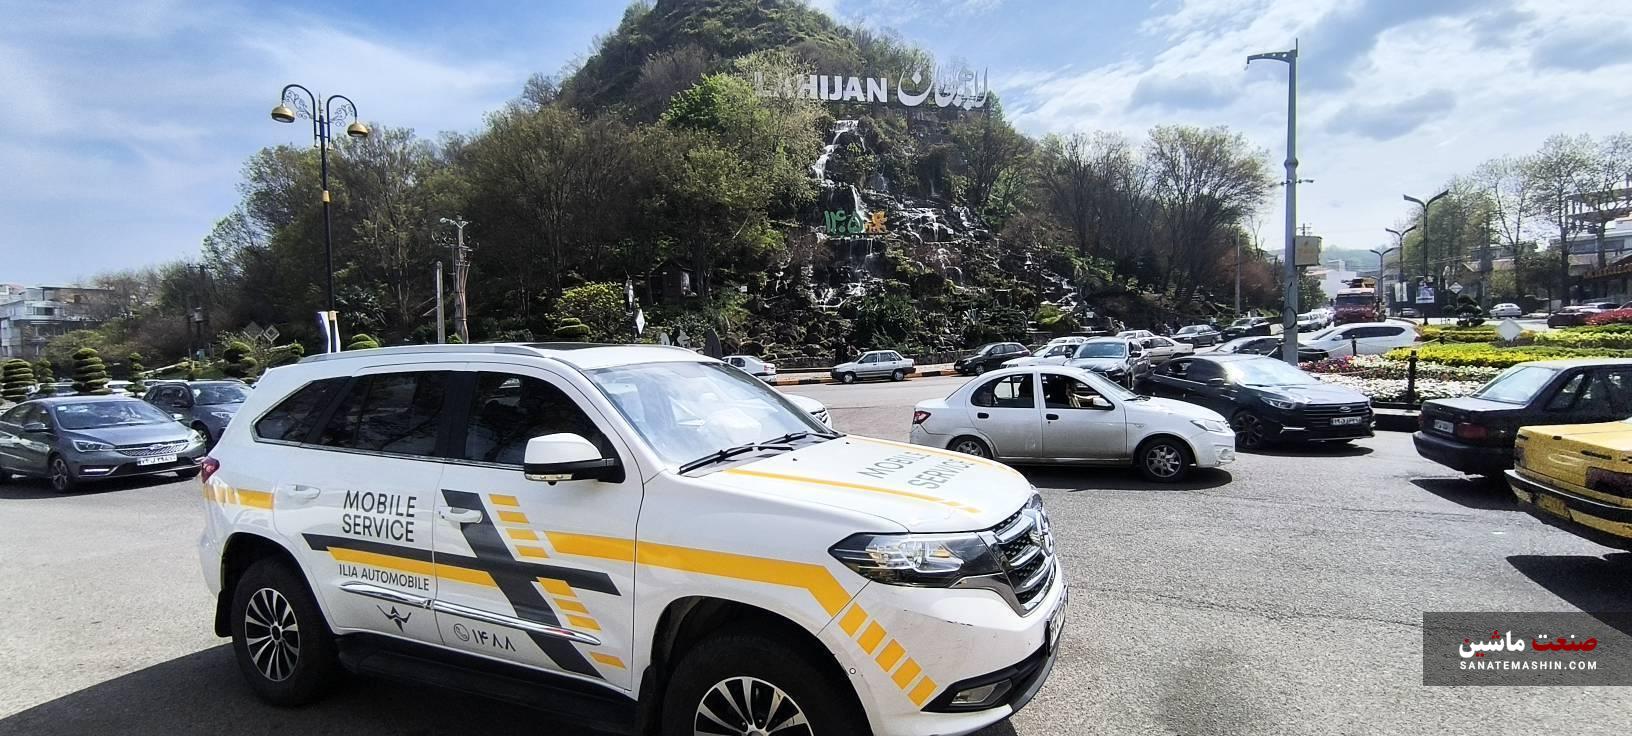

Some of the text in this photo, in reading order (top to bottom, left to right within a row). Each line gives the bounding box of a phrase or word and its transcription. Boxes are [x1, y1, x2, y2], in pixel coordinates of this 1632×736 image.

[856, 452, 931, 479] MOBILE
[907, 459, 975, 489] SERVICE
[343, 489, 417, 518] MOBILE
[342, 513, 415, 543] SERVICE
[339, 563, 430, 591] ILIA AUTOMOBILE
[471, 629, 516, 652] ۱۴۸۸
